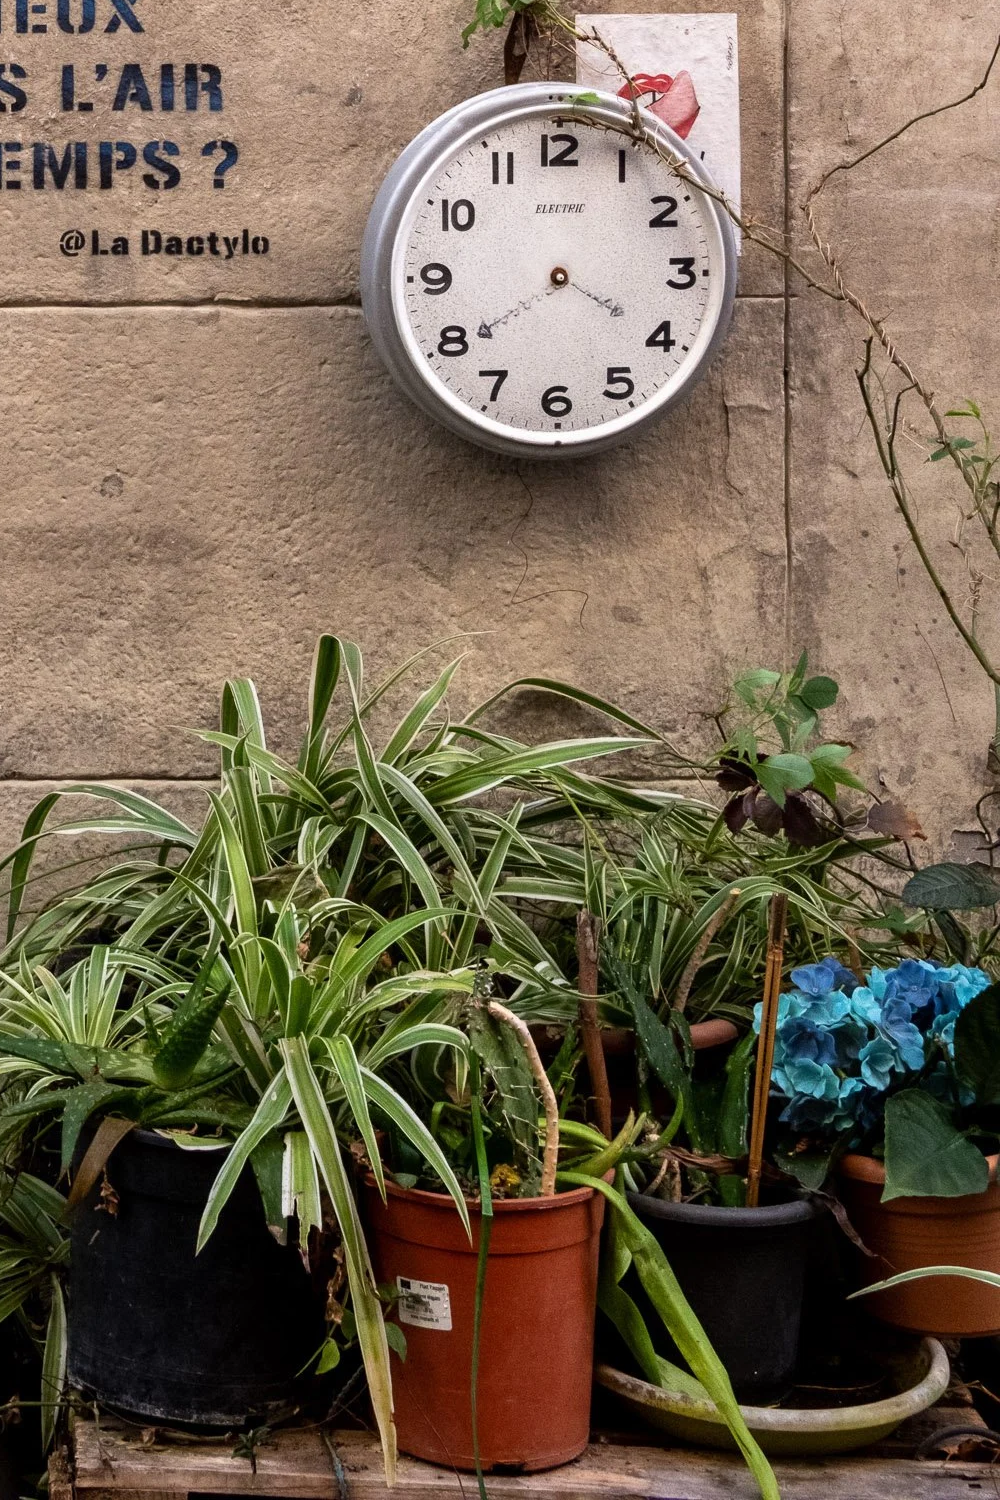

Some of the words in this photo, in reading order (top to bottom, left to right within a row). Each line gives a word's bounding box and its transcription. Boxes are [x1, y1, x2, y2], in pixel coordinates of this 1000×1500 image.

[60, 63, 223, 112] L'AIR
[201, 140, 239, 189] ?
[540, 133, 579, 167] 12
[618, 149, 626, 183] 1
[492, 151, 514, 185] 11
[441, 199, 475, 232] 10
[535, 203, 586, 214] ELECTRIC
[649, 195, 678, 228] 2
[59, 229, 129, 257] @La
[141, 228, 270, 260] Dactylo
[420, 262, 453, 295] 9
[666, 257, 697, 290] 3
[437, 325, 469, 357] 8
[645, 320, 676, 353] 4
[478, 369, 508, 402] 7
[602, 366, 635, 400] 5
[541, 385, 573, 418] 6
